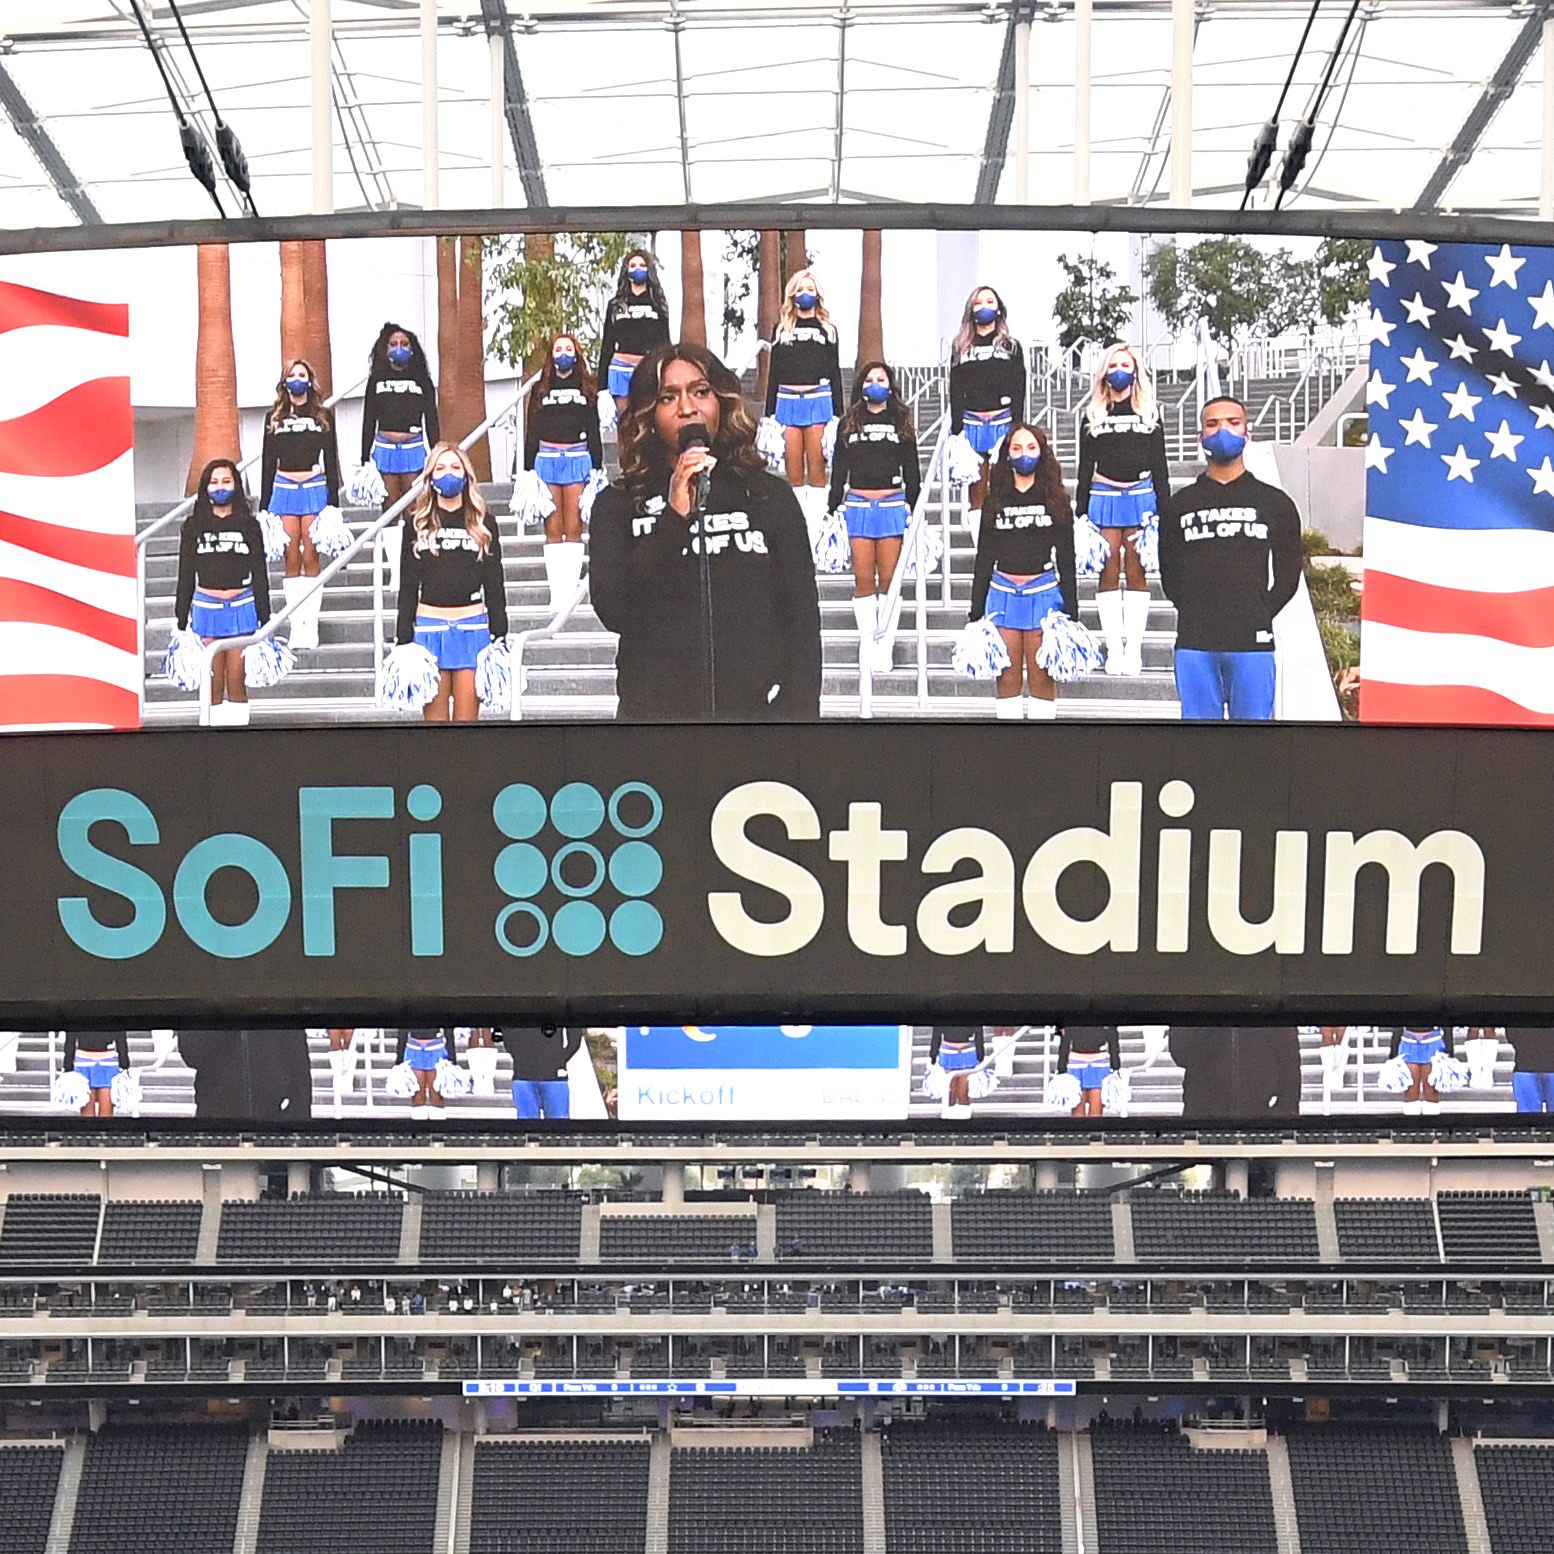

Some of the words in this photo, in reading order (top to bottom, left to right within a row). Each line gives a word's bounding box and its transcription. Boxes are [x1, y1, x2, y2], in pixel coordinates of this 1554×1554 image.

[631, 515, 657, 538] IT
[1014, 515, 1034, 528] OF
[1033, 514, 1053, 528] US
[1179, 513, 1197, 529] IT
[1198, 507, 1258, 524] TAKES
[734, 531, 769, 555] US
[1184, 526, 1215, 543] ALL
[1216, 523, 1244, 539] OF
[1244, 523, 1270, 540] US
[53, 781, 447, 963] SoFi
[705, 778, 1489, 962] Stadium
[637, 1085, 735, 1106] Kickoff
